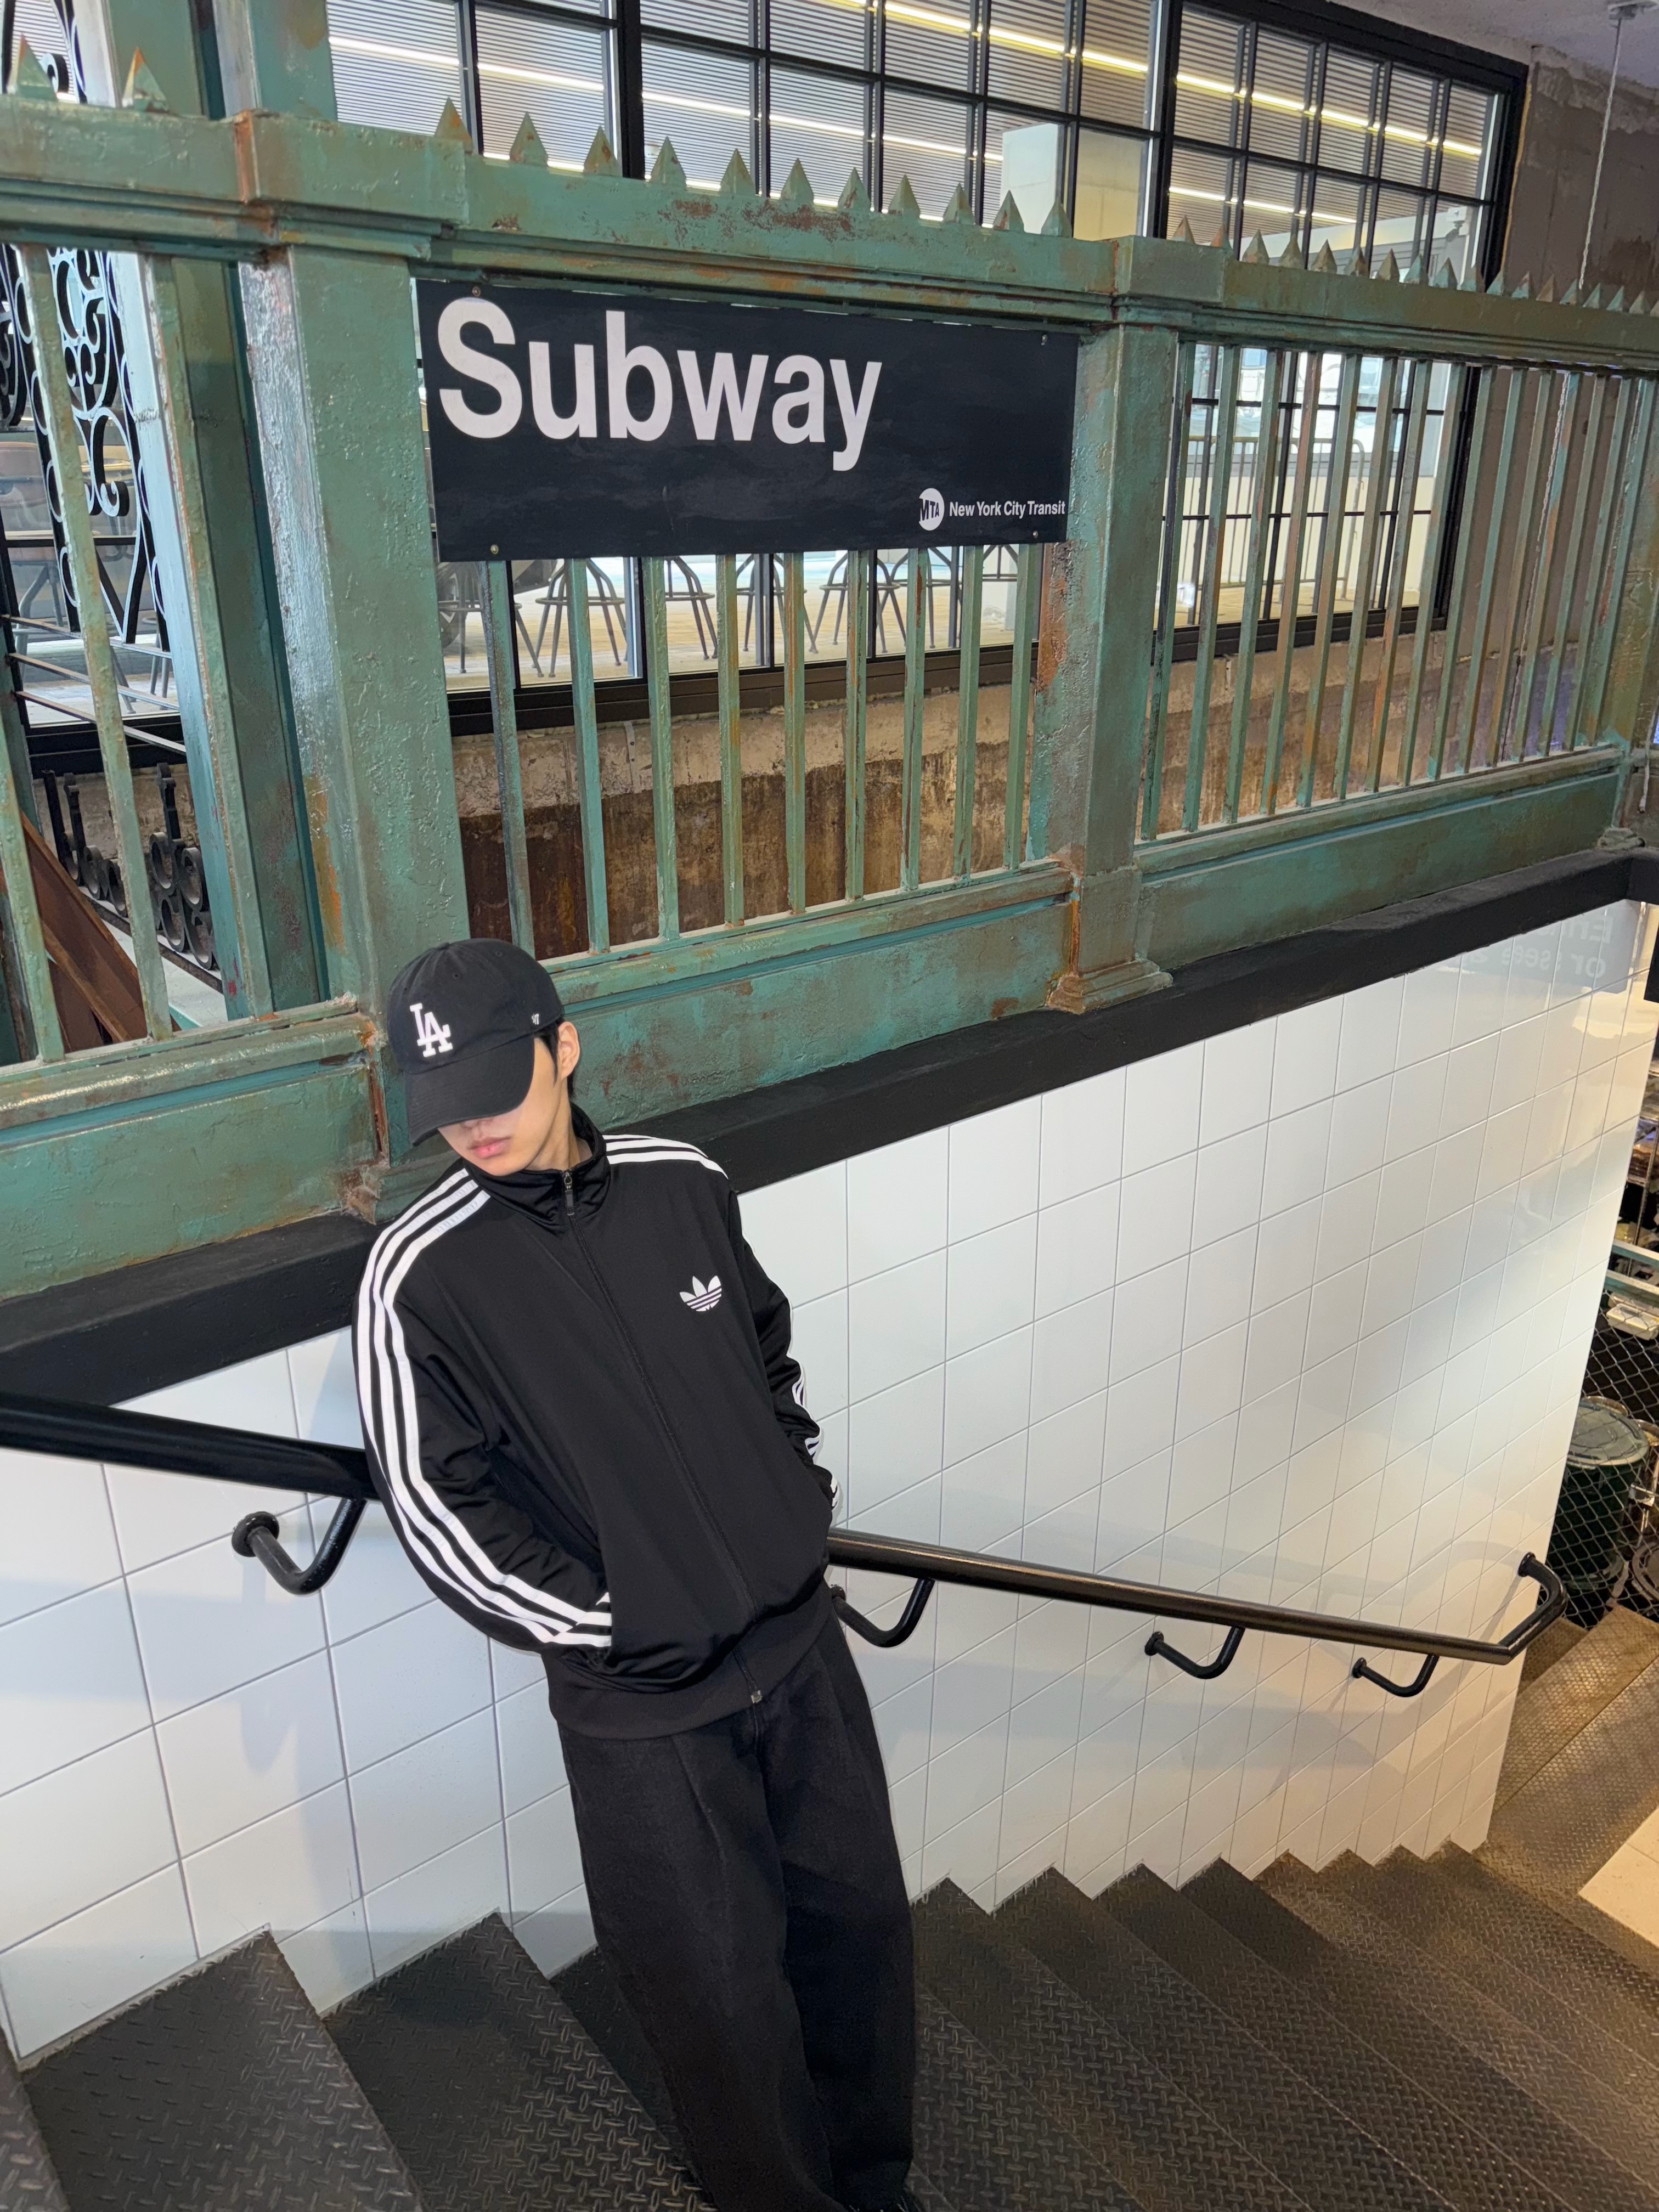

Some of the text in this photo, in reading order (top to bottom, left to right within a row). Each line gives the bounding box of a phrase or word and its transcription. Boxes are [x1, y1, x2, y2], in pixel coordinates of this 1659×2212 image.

[438, 297, 882, 471] Subway
[918, 496, 1065, 522] MTA New York City Transit
[409, 1002, 453, 1058] LA
